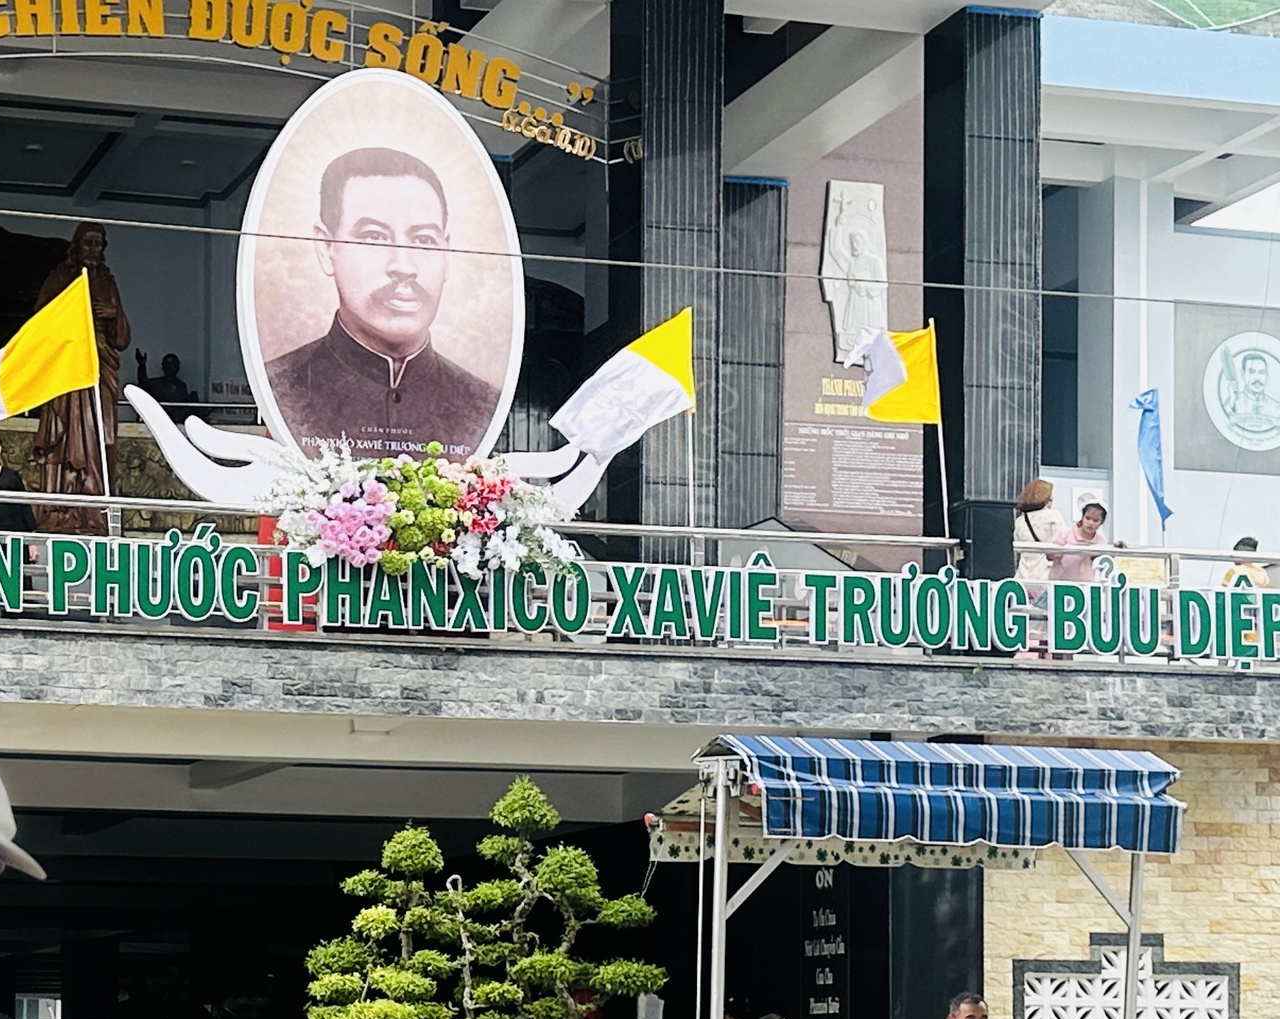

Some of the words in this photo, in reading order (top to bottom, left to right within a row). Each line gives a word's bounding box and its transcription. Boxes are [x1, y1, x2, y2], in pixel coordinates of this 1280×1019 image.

[50, 522, 259, 622] PHƯỚC
[605, 550, 781, 644] XAVIÊ
[802, 561, 1028, 652] TRƯƠNG
[1051, 554, 1162, 656] BỬU
